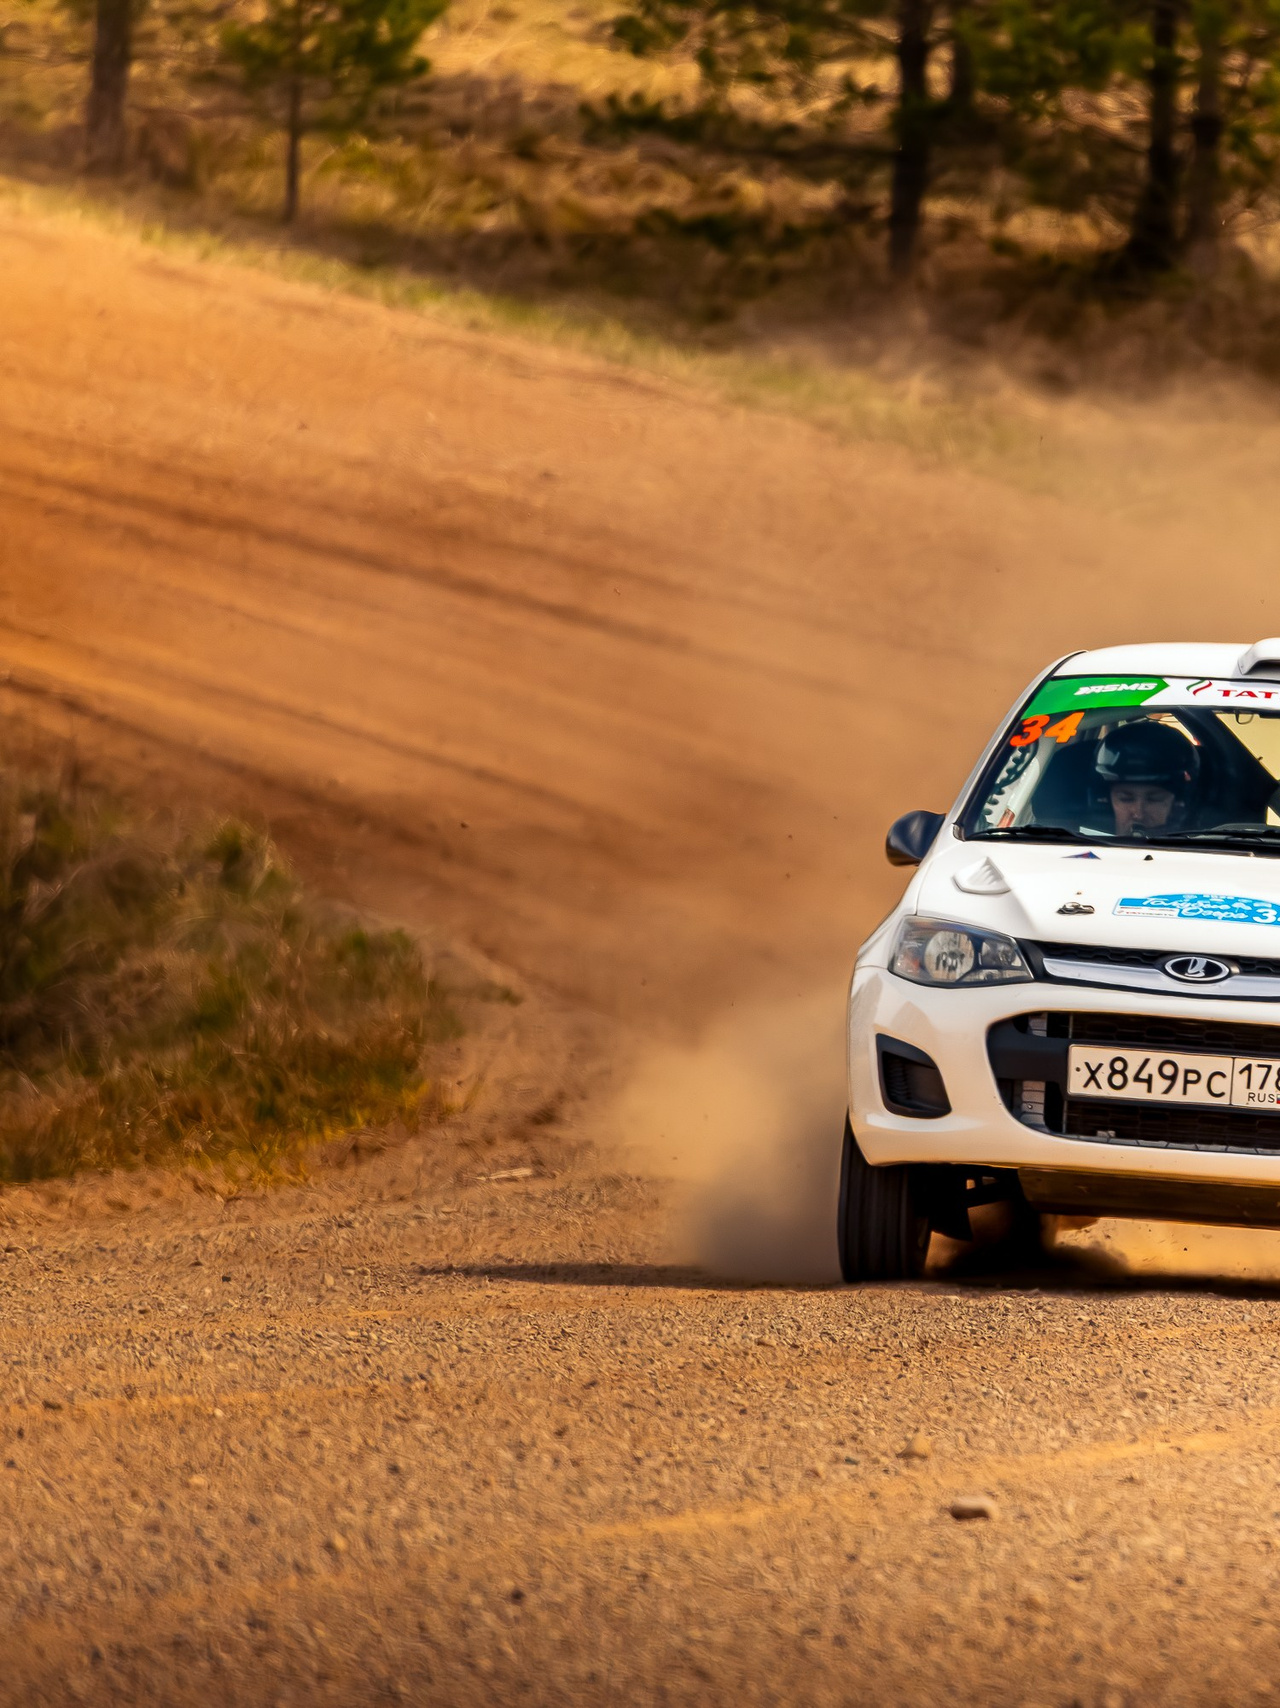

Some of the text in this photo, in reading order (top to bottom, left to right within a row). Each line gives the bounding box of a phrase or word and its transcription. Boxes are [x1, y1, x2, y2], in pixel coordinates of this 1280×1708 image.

[1009, 711, 1085, 747] 34
[1082, 1056, 1228, 1098] Х849РС
[1247, 1091, 1276, 1104] RUS
